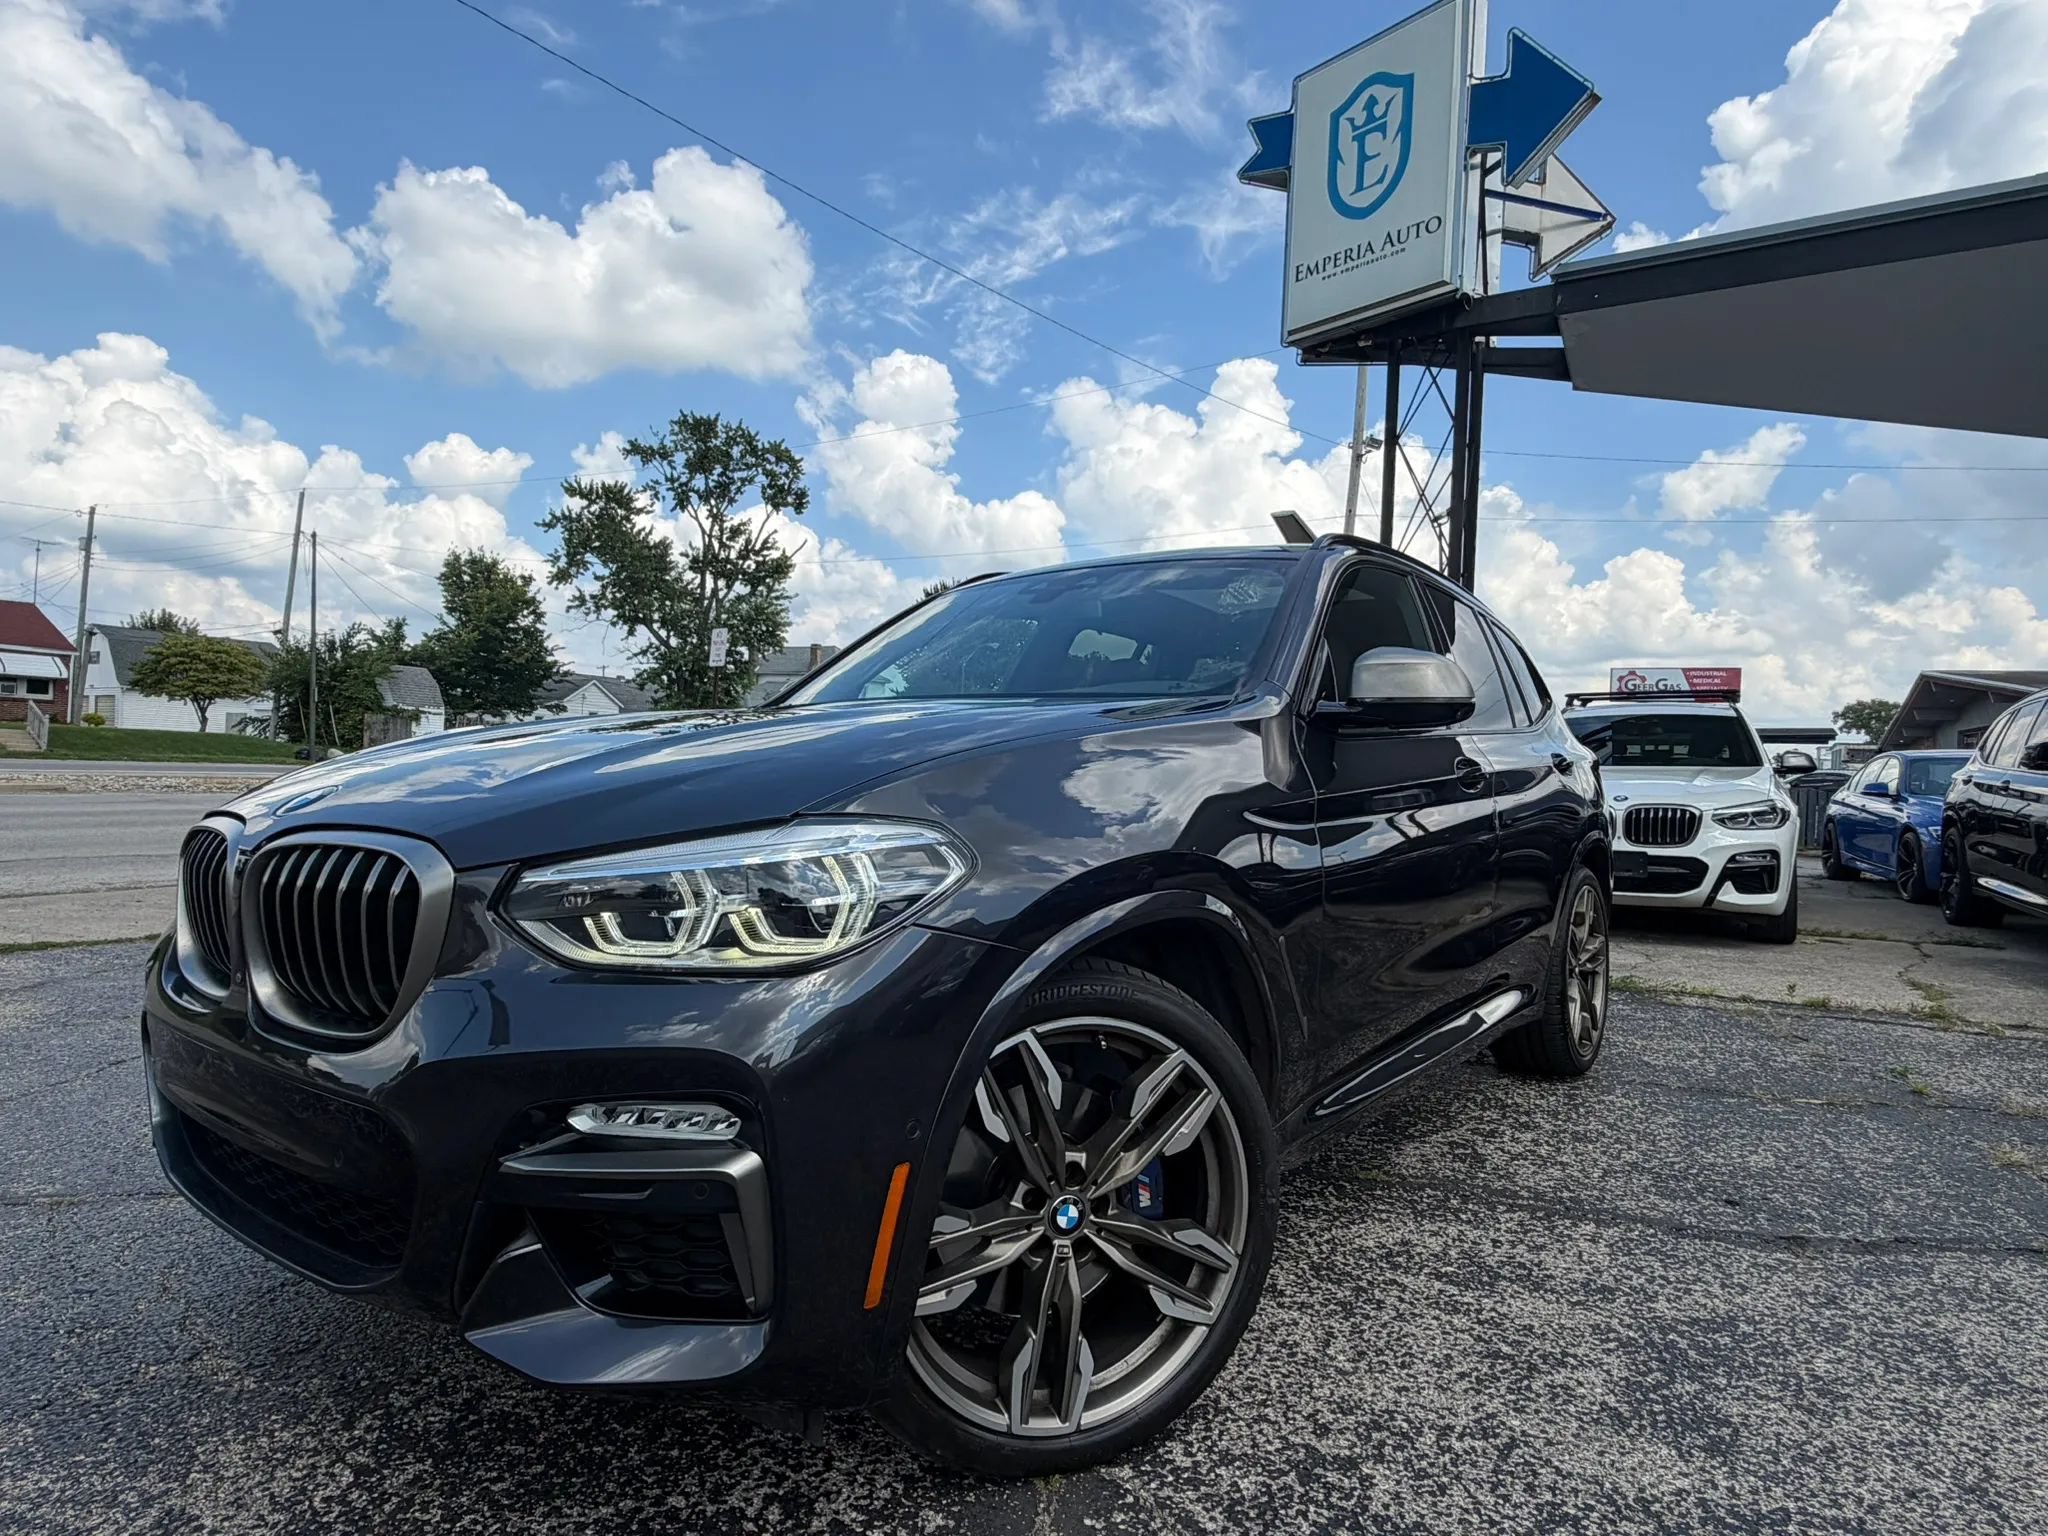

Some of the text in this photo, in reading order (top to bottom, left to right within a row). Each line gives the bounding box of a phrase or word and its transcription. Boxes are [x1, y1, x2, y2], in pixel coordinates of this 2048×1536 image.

[1295, 215, 1442, 283] EMPERIA AUTO
[1025, 983, 1139, 1008] BRIDGESTONE
